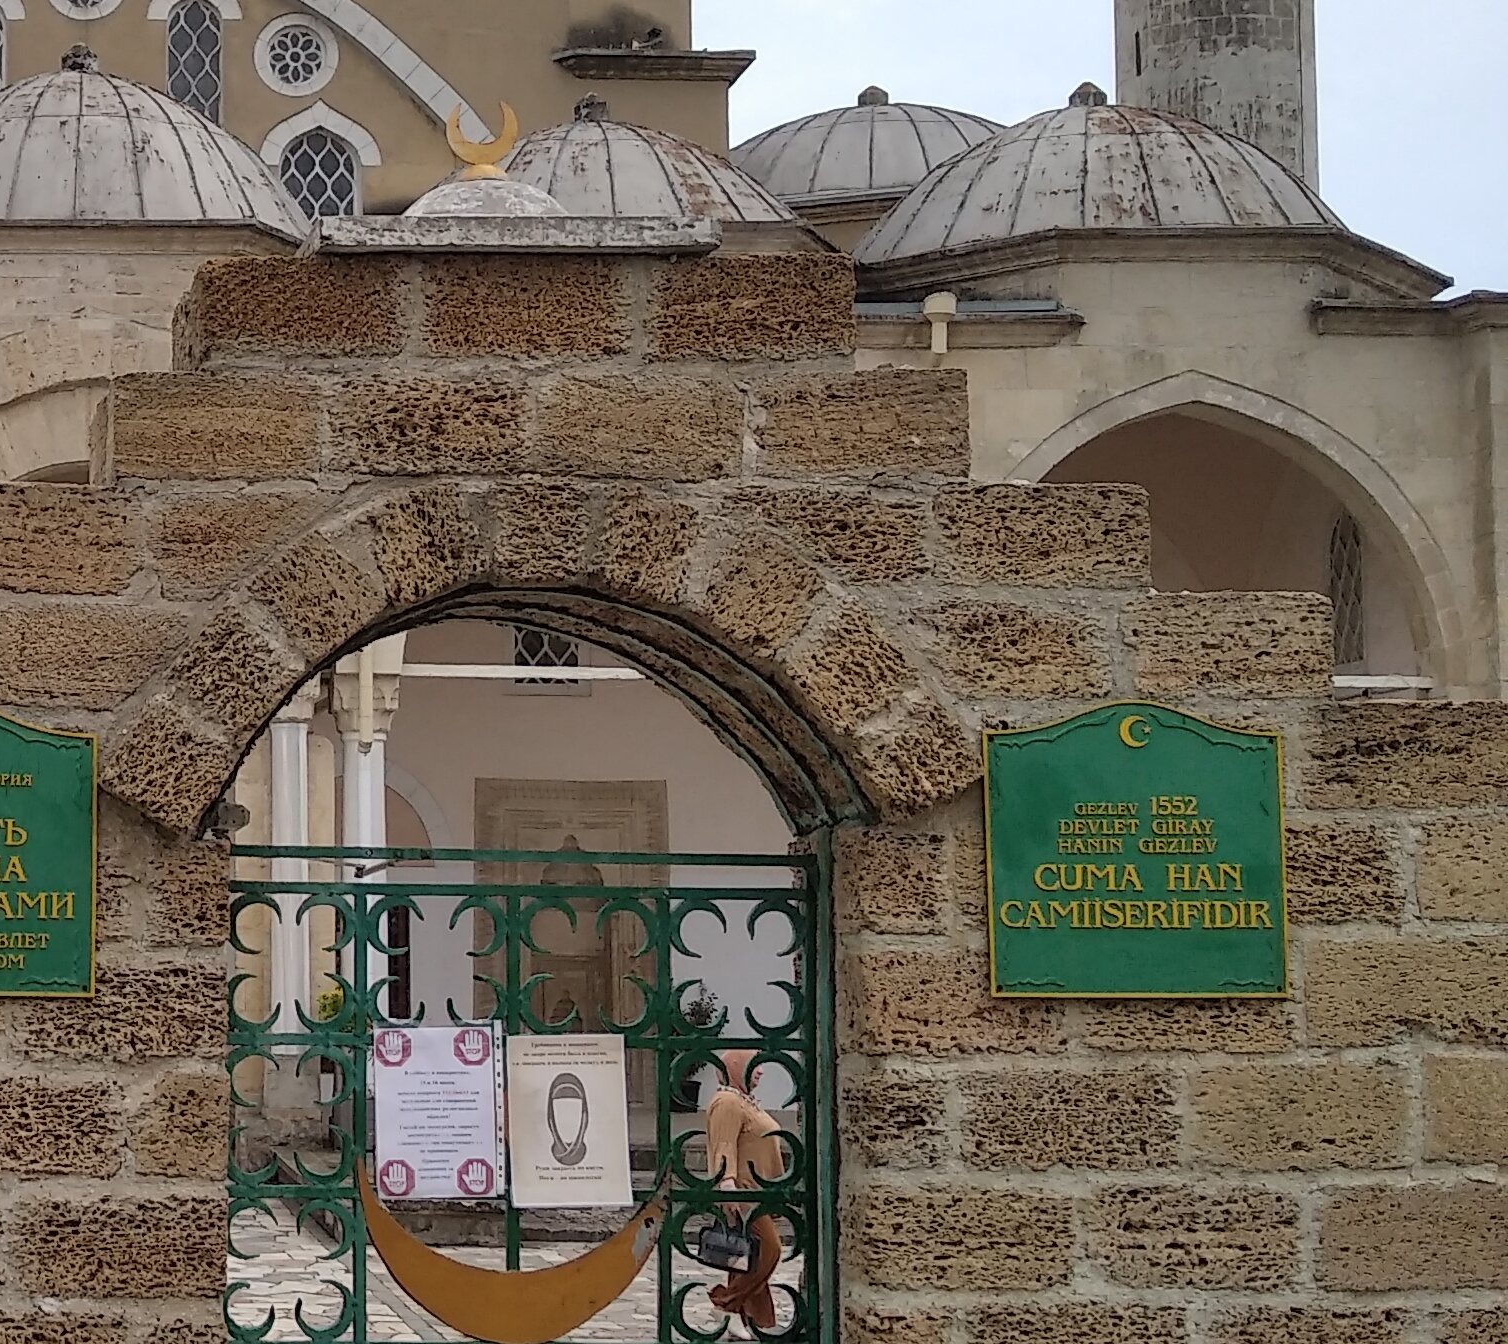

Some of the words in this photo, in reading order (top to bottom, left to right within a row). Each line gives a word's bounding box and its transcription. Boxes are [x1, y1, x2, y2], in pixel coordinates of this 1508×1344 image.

[1074, 802, 1139, 816] GEZLEV
[1150, 796, 1198, 816] 1552
[1059, 819, 1139, 835] DEVLET
[1058, 838, 1123, 854] HANIN
[1139, 838, 1218, 853] GEZLEV
[1034, 864, 1144, 891] CUMA
[1167, 864, 1242, 891] HAN
